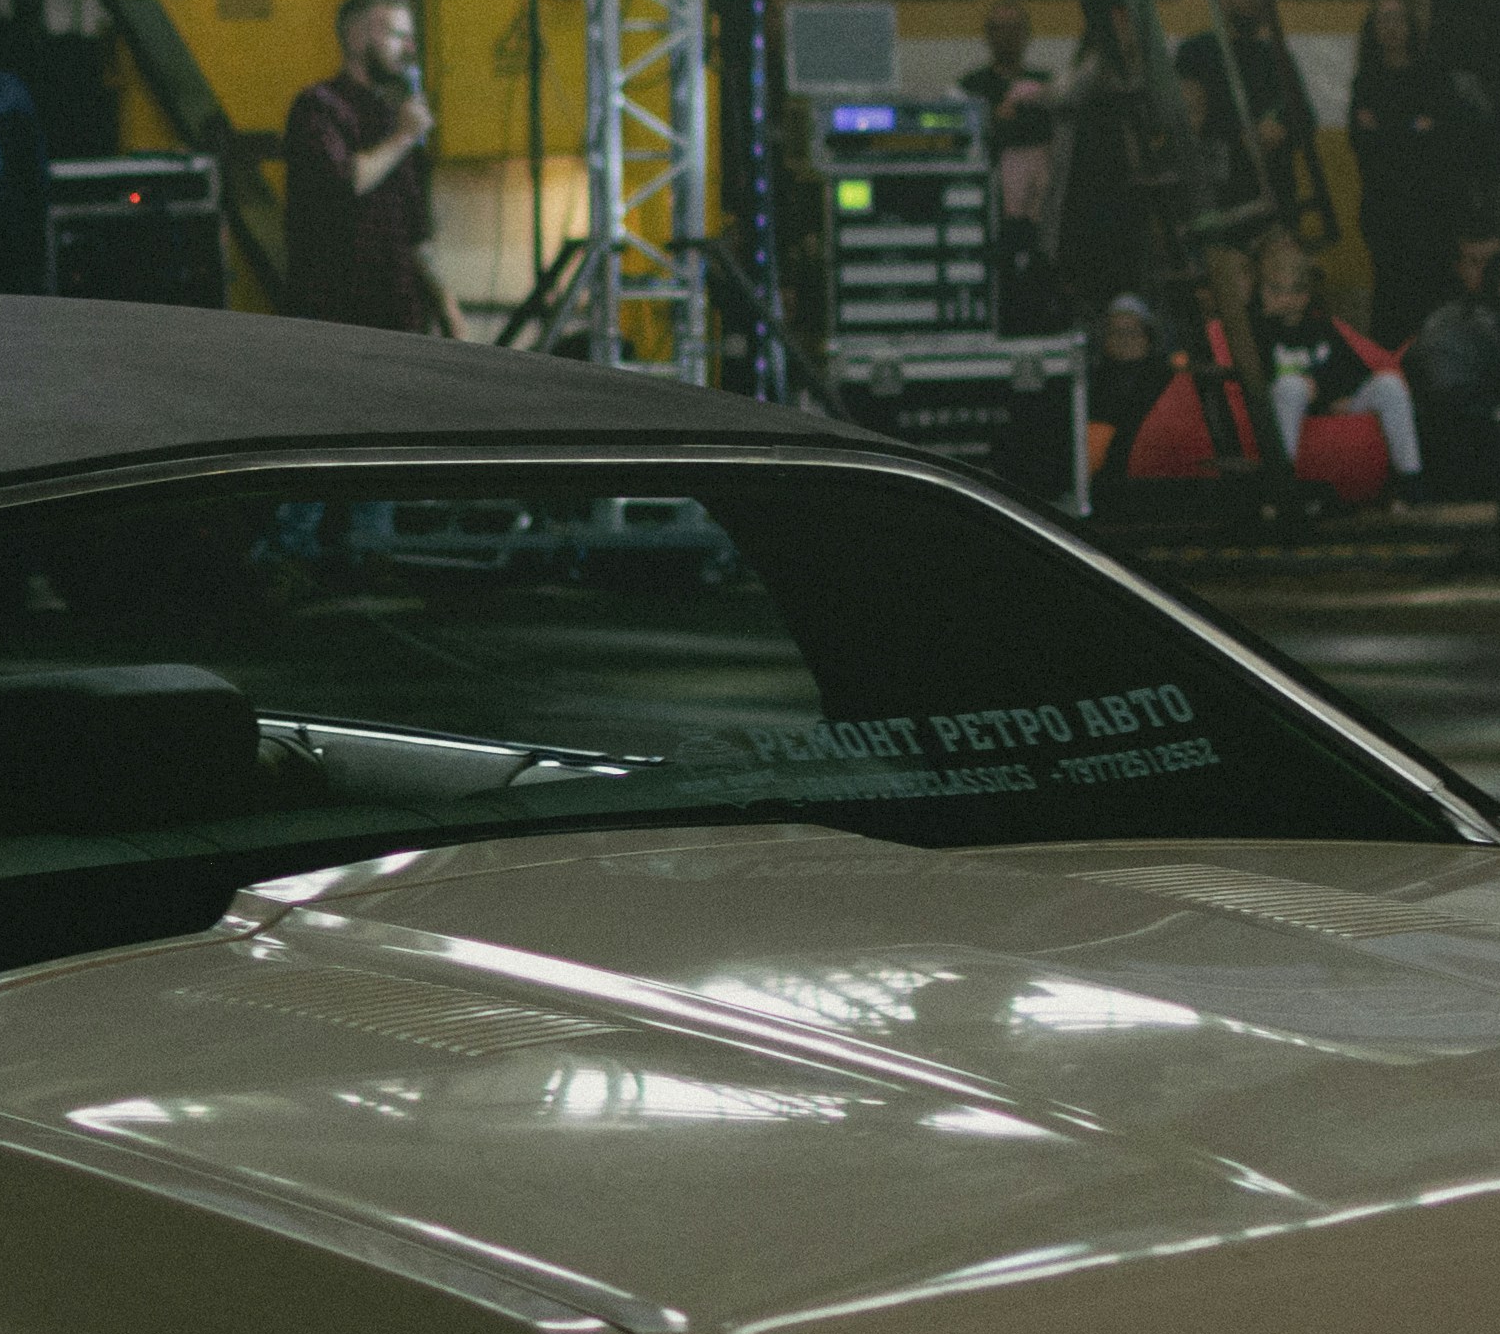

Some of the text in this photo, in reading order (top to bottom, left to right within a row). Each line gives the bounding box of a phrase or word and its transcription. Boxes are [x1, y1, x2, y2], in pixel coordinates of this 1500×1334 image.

[748, 682, 1196, 764] РЕМОНТ РЕТРО АВТО
